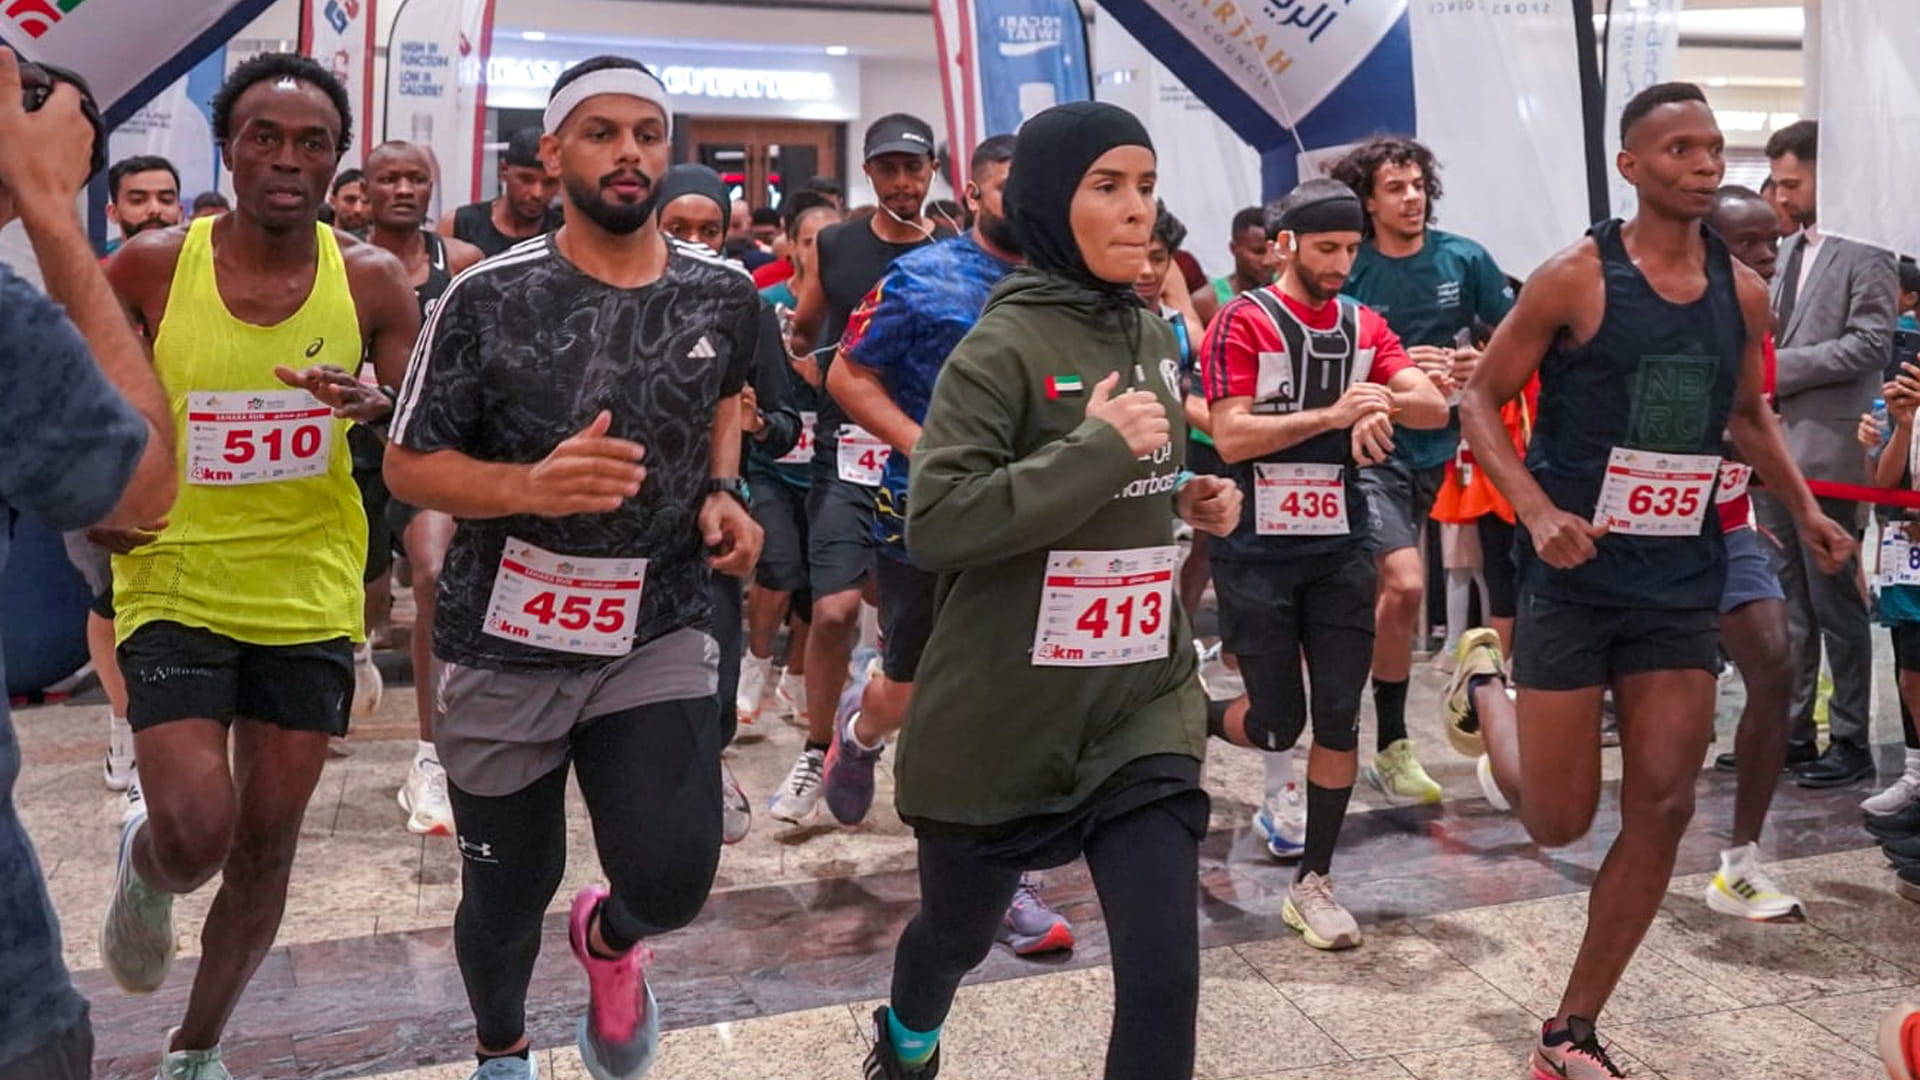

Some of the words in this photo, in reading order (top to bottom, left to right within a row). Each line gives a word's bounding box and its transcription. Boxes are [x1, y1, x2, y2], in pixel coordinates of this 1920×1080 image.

[223, 425, 321, 463] 510
[1279, 491, 1339, 519] 436
[1628, 485, 1702, 517] 635
[523, 591, 626, 633] 455
[1076, 591, 1162, 639] 413
